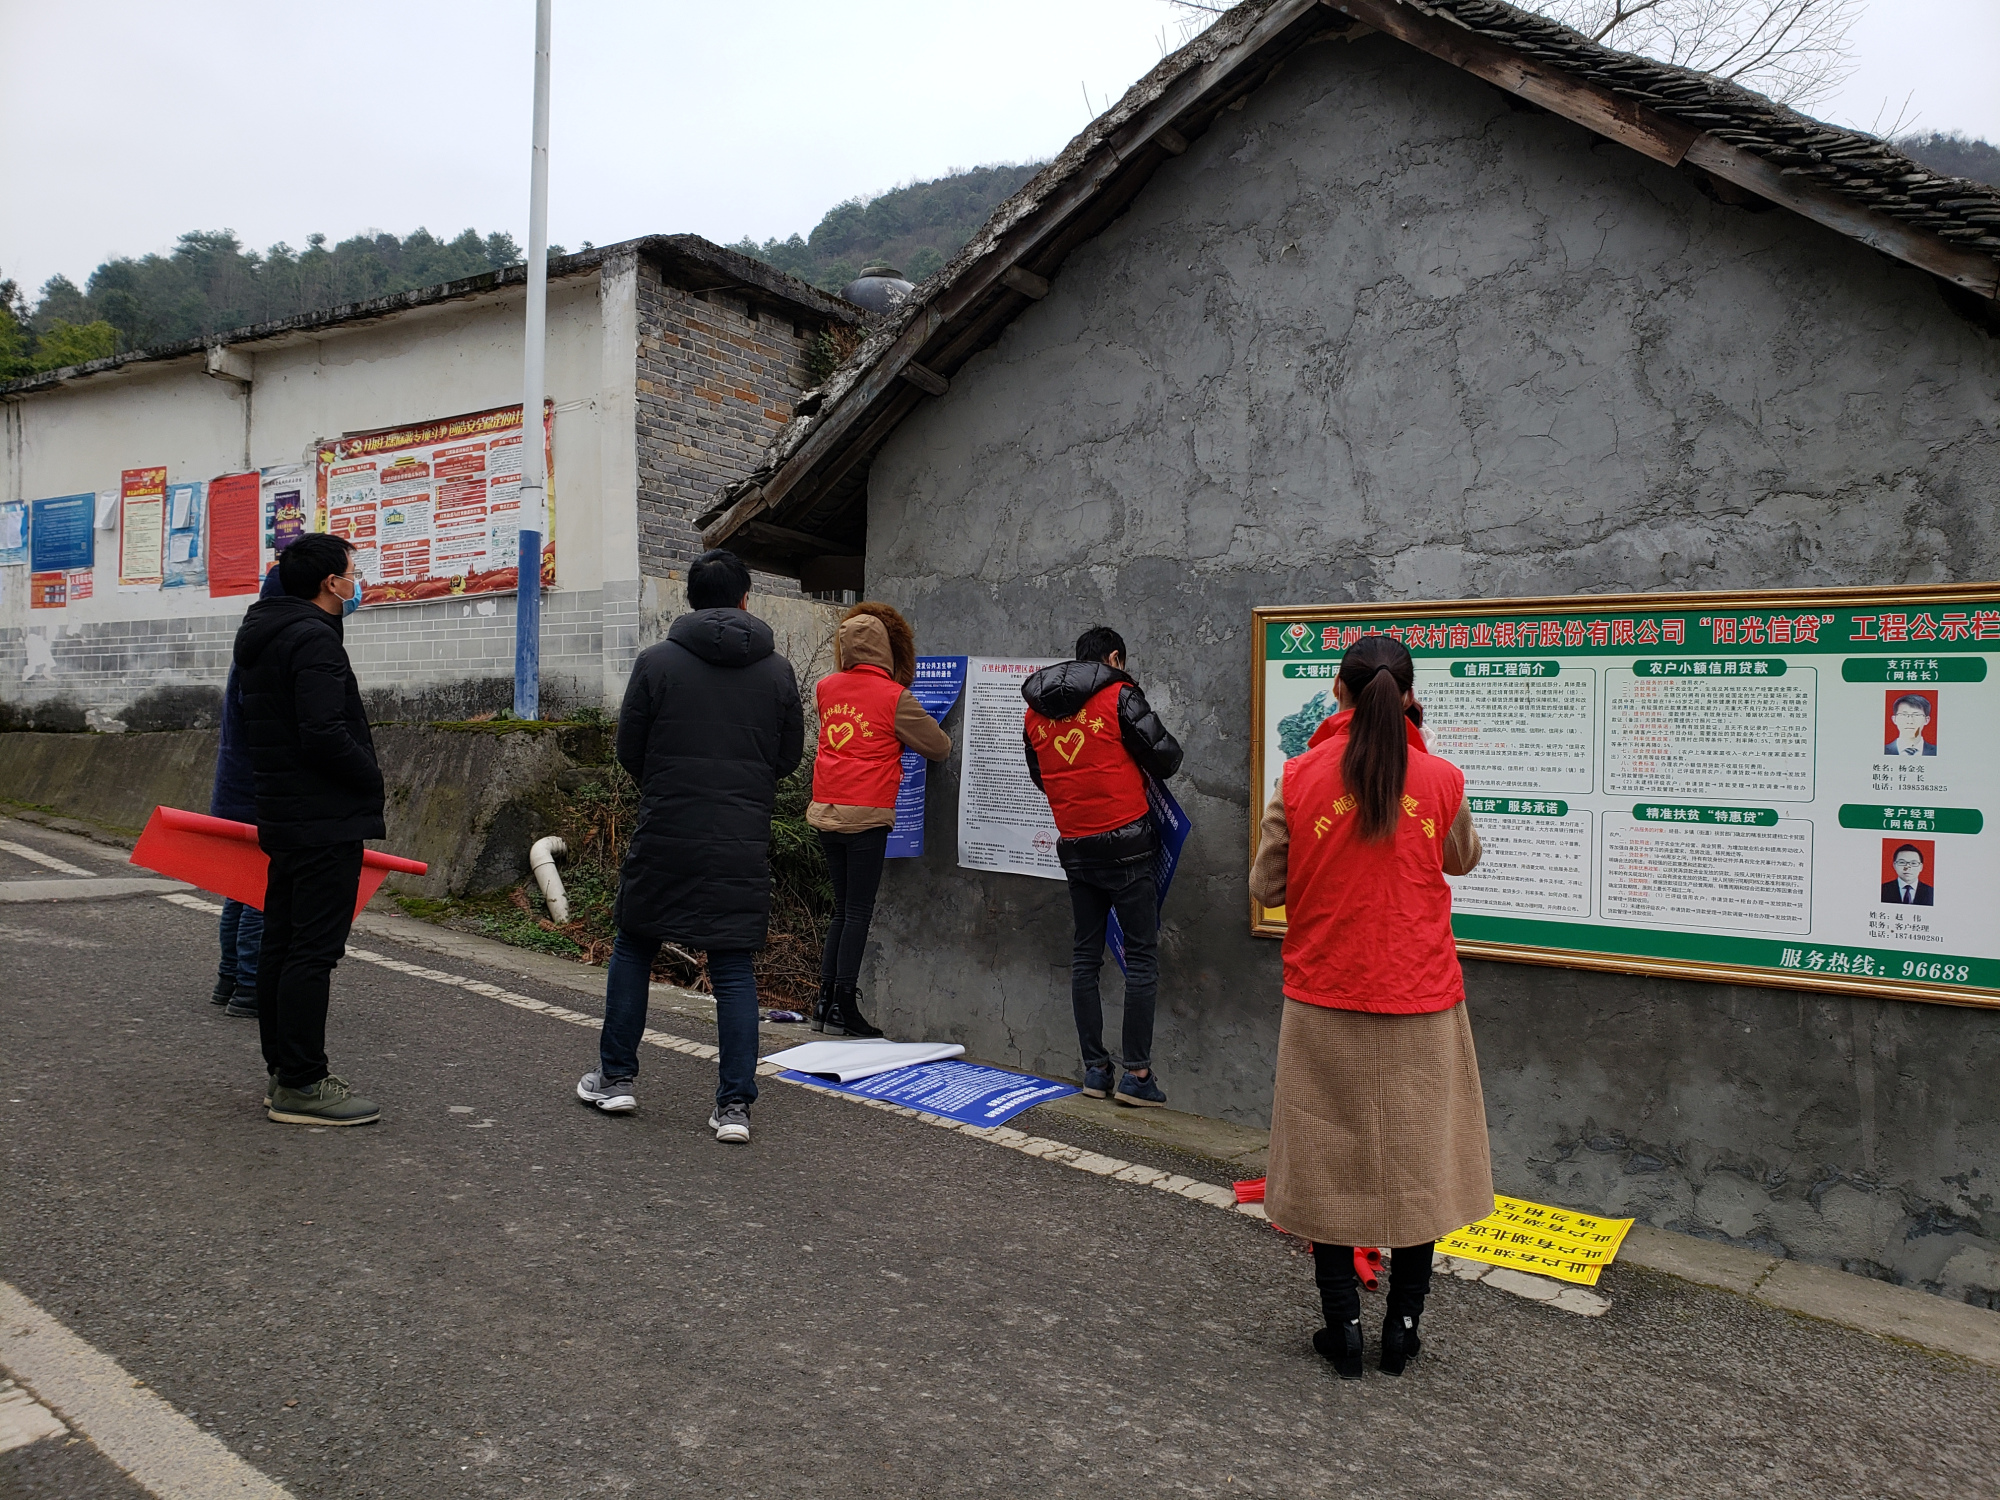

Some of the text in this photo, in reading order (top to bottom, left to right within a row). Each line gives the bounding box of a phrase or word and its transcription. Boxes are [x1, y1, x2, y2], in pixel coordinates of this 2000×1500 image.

[1464, 662, 1545, 676] 信用工程简介
[1649, 661, 1769, 675] 农户小额信用贷款
[1887, 659, 1939, 670] 支行行长
[1886, 671, 1939, 681] （网格长）
[1872, 763, 1925, 773] 姓名：杨金亮
[1313, 793, 1436, 839] 巾帼愿者
[1645, 807, 1765, 824] 精准扶贫“特惠贷”
[1883, 808, 1936, 819] 客户经理
[1882, 819, 1936, 831] （网格员）
[1779, 947, 1970, 982] 服务热线：96688
[1502, 1201, 1598, 1229] 请勿相互
